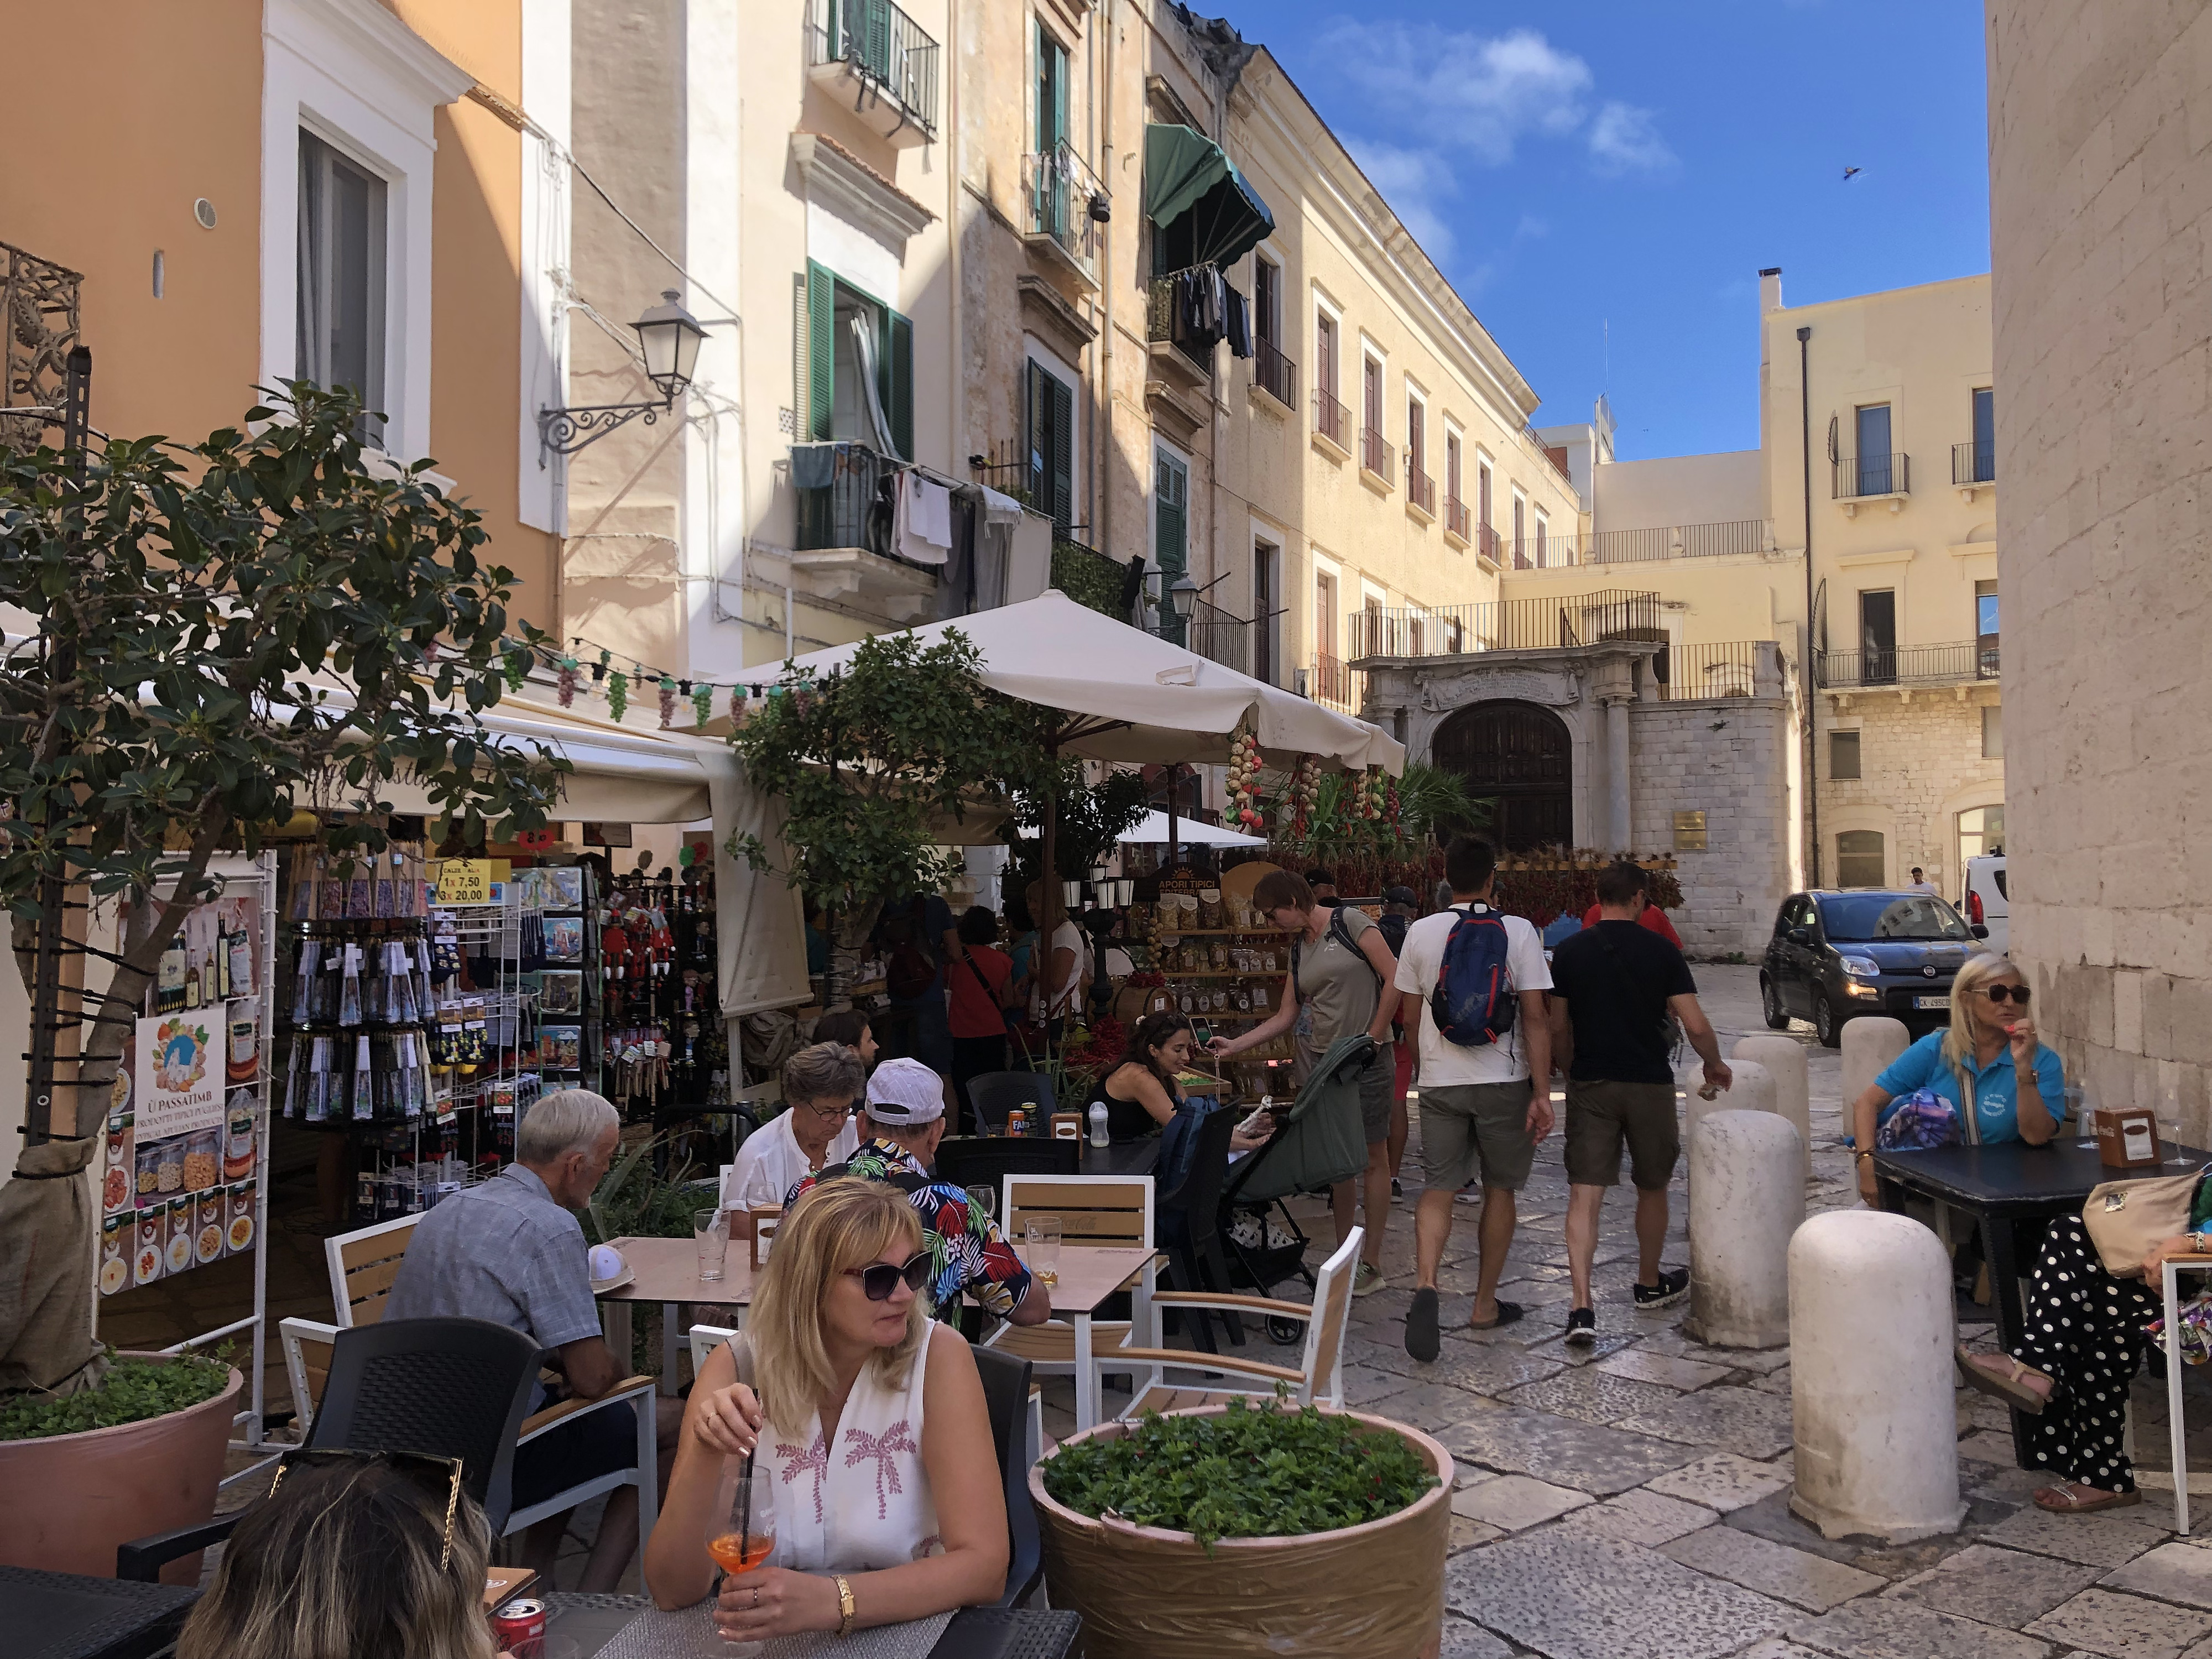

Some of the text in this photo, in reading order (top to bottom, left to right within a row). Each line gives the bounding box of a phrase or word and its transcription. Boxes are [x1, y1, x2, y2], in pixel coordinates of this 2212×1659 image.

[459, 877, 479, 889] 7,50
[1190, 880, 1215, 888] TIPICI
[455, 890, 482, 902] 20,00
